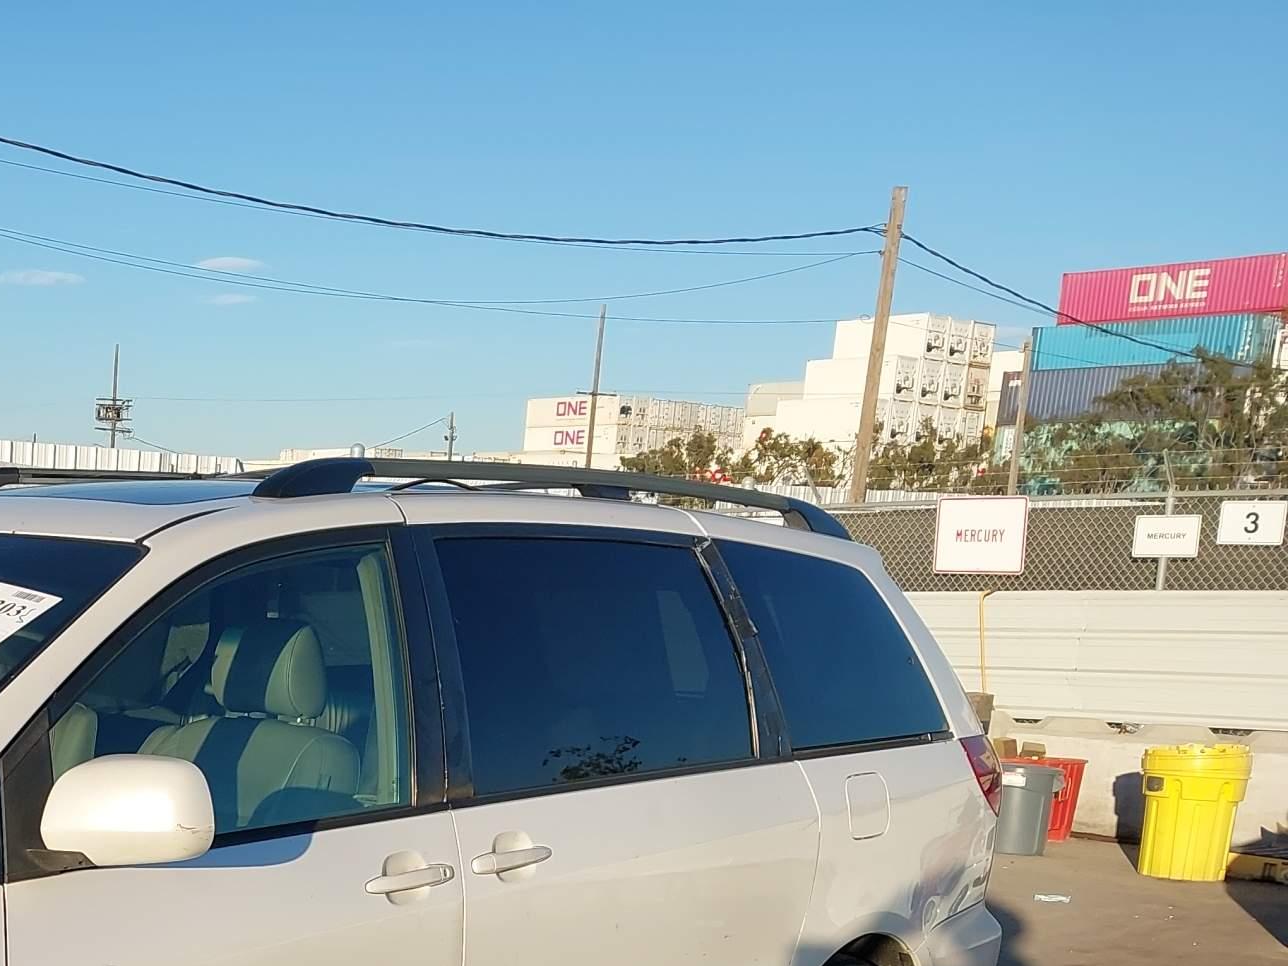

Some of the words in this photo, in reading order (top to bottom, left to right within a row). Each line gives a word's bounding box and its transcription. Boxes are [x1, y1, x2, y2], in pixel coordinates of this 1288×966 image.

[1129, 268, 1211, 304] ONE
[556, 400, 588, 417] ONE
[553, 429, 586, 446] ONE
[1244, 511, 1260, 534] 3
[955, 528, 1005, 544] MERCURY
[1146, 531, 1187, 541] MERCURY
